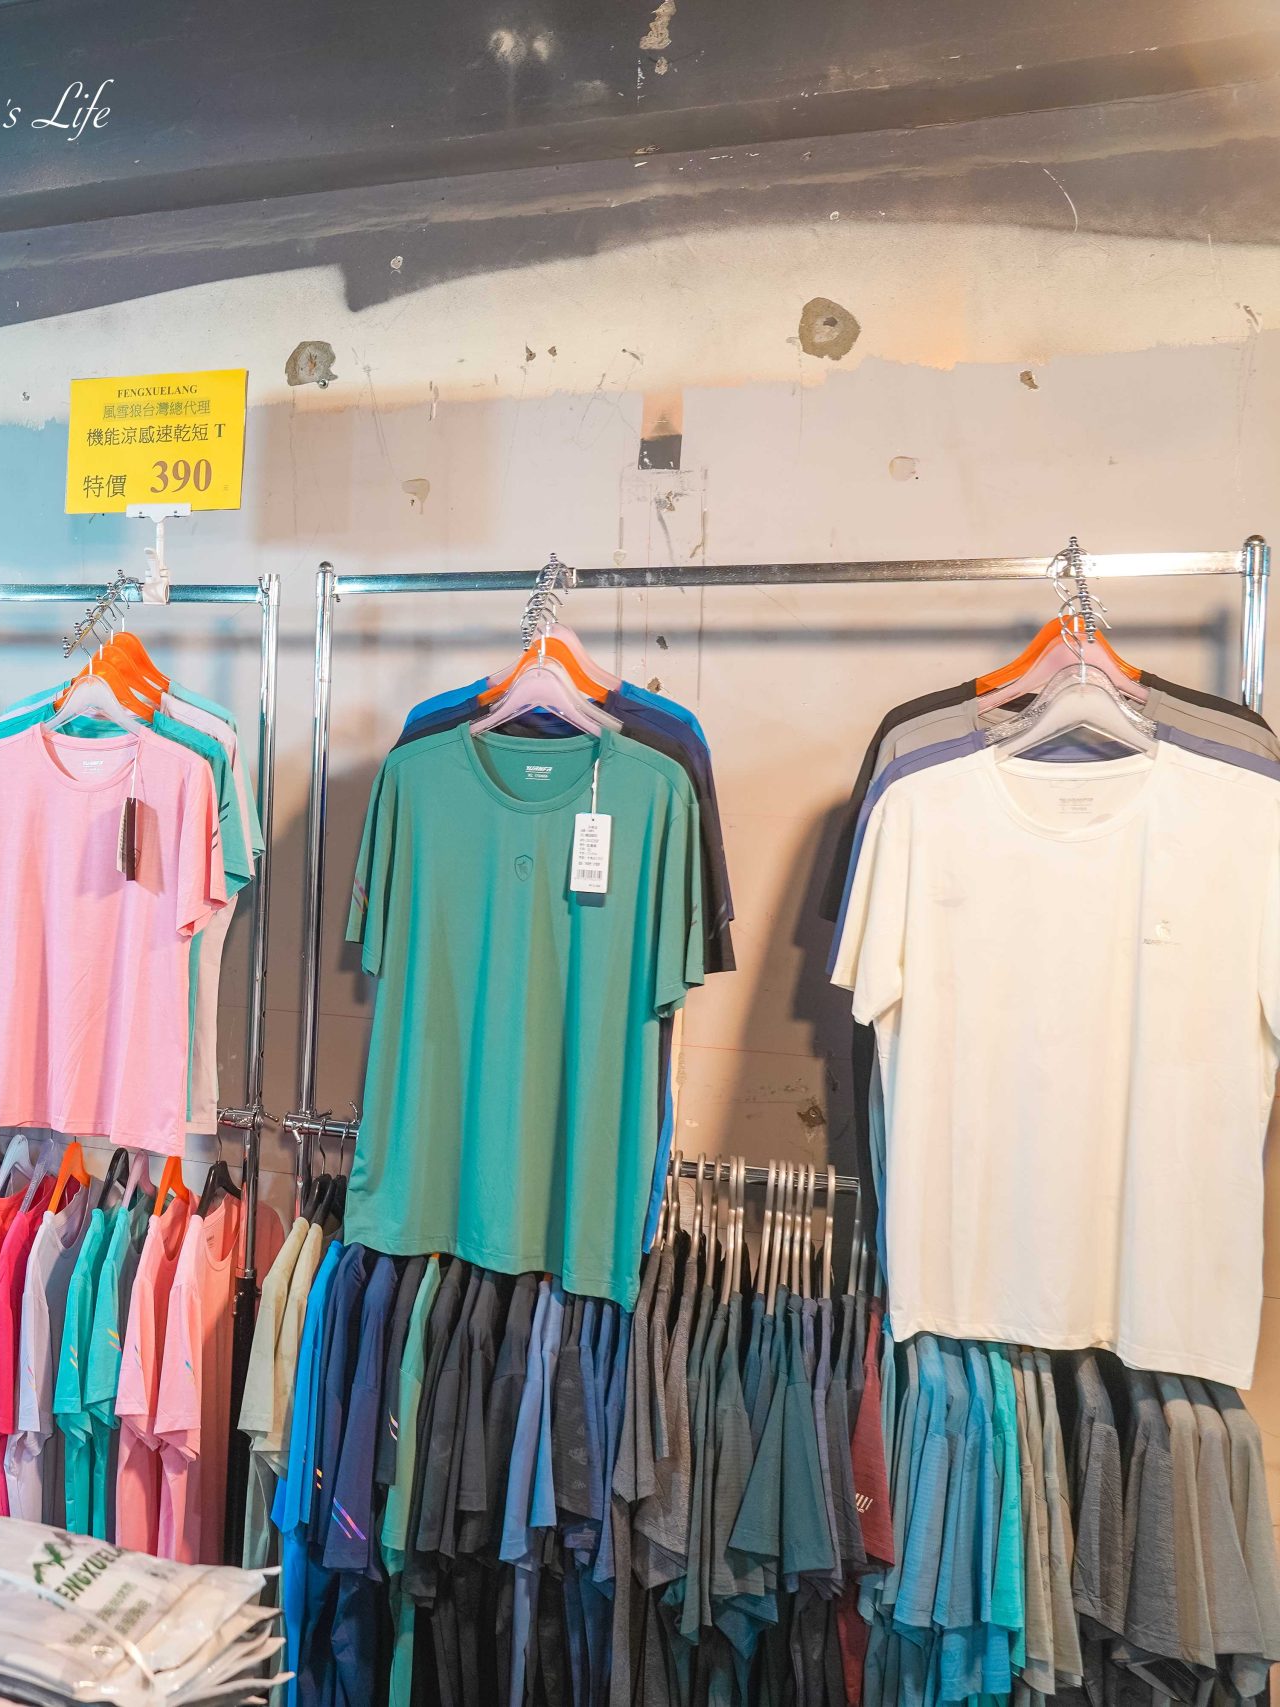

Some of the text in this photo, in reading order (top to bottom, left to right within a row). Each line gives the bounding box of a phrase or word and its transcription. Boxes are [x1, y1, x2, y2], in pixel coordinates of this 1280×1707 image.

[117, 385, 198, 398] FENGXUELANG
[214, 423, 226, 438] T
[83, 458, 212, 498] 特價 390
